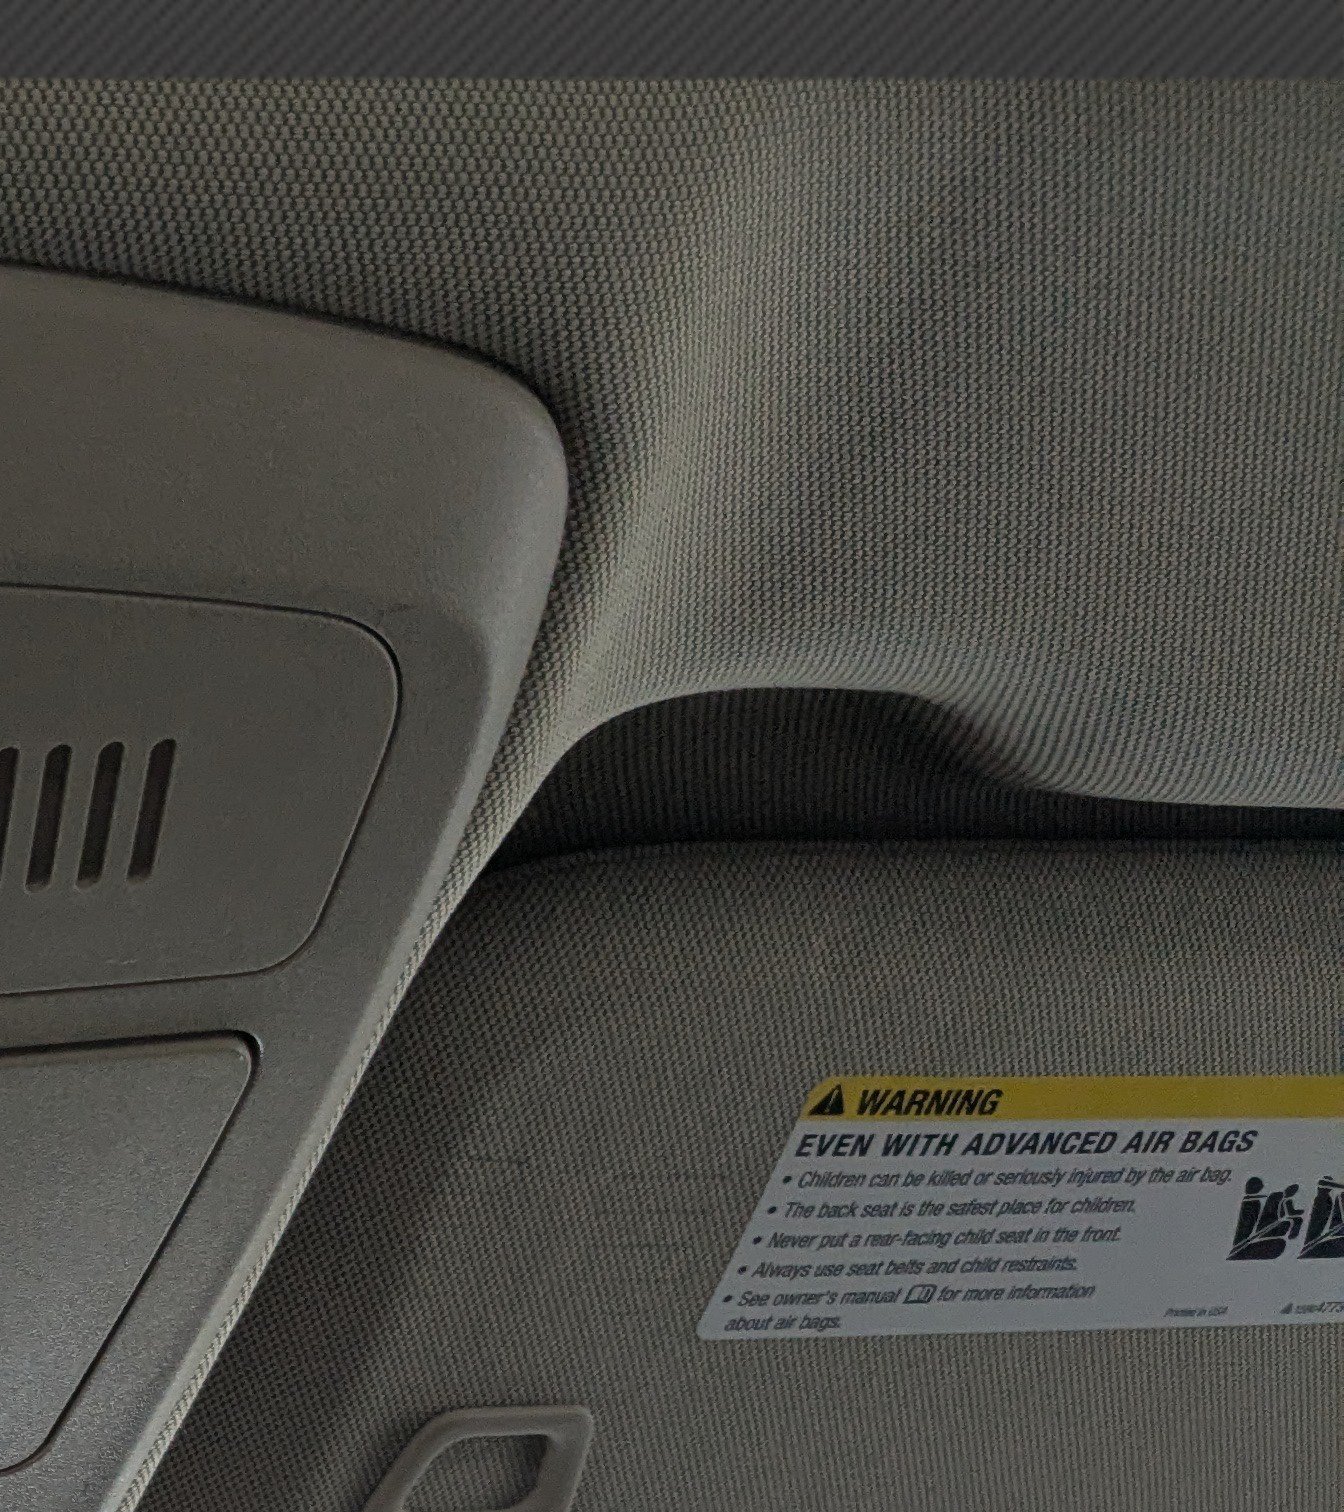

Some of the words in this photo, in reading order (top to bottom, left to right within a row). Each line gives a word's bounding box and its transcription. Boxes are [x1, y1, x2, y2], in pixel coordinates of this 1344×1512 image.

[857, 1089, 1004, 1115] WARNING
[795, 1133, 875, 1158] EVEN
[882, 1133, 960, 1157] WITH
[962, 1132, 1117, 1156] ADVANCED
[1121, 1131, 1174, 1154] AIR
[1179, 1130, 1258, 1154] BAGS
[797, 1169, 865, 1188] Children
[868, 1173, 897, 1188] can
[901, 1169, 924, 1187] be
[927, 1168, 971, 1187] killed
[973, 1170, 994, 1186] or
[996, 1167, 1065, 1188] seriously
[1067, 1167, 1125, 1187] injured
[1125, 1168, 1148, 1187] by
[1149, 1166, 1174, 1183] the
[1175, 1166, 1200, 1183] air
[1200, 1166, 1232, 1185] bag.
[784, 1201, 812, 1219] The
[817, 1201, 857, 1218] back
[860, 1201, 897, 1218] seat
[899, 1201, 914, 1217] is
[917, 1200, 942, 1217] the
[946, 1199, 995, 1217] safest
[997, 1199, 1042, 1217] place
[1043, 1198, 1070, 1215] for
[1070, 1197, 1135, 1215] children.
[767, 1231, 819, 1249] Never
[817, 1233, 848, 1251] put
[848, 1235, 861, 1248] a
[864, 1229, 952, 1249] rear-facing
[953, 1228, 996, 1246] child
[996, 1228, 1034, 1244] seat
[1034, 1228, 1050, 1243] in
[1052, 1226, 1079, 1243] the
[751, 1262, 811, 1281] Always
[813, 1264, 845, 1277] use
[845, 1261, 884, 1277] seat
[884, 1259, 925, 1276] belts
[926, 1258, 960, 1275] and
[960, 1257, 1002, 1274] child
[1002, 1256, 1077, 1272] restraints.
[738, 1291, 771, 1307] See
[773, 1290, 839, 1306] owner's
[840, 1288, 902, 1304] manual
[938, 1285, 962, 1302] for
[963, 1287, 1005, 1302] more
[1007, 1284, 1096, 1301] information
[724, 1315, 773, 1331] about
[774, 1314, 798, 1330] air
[799, 1314, 841, 1332] bags.
